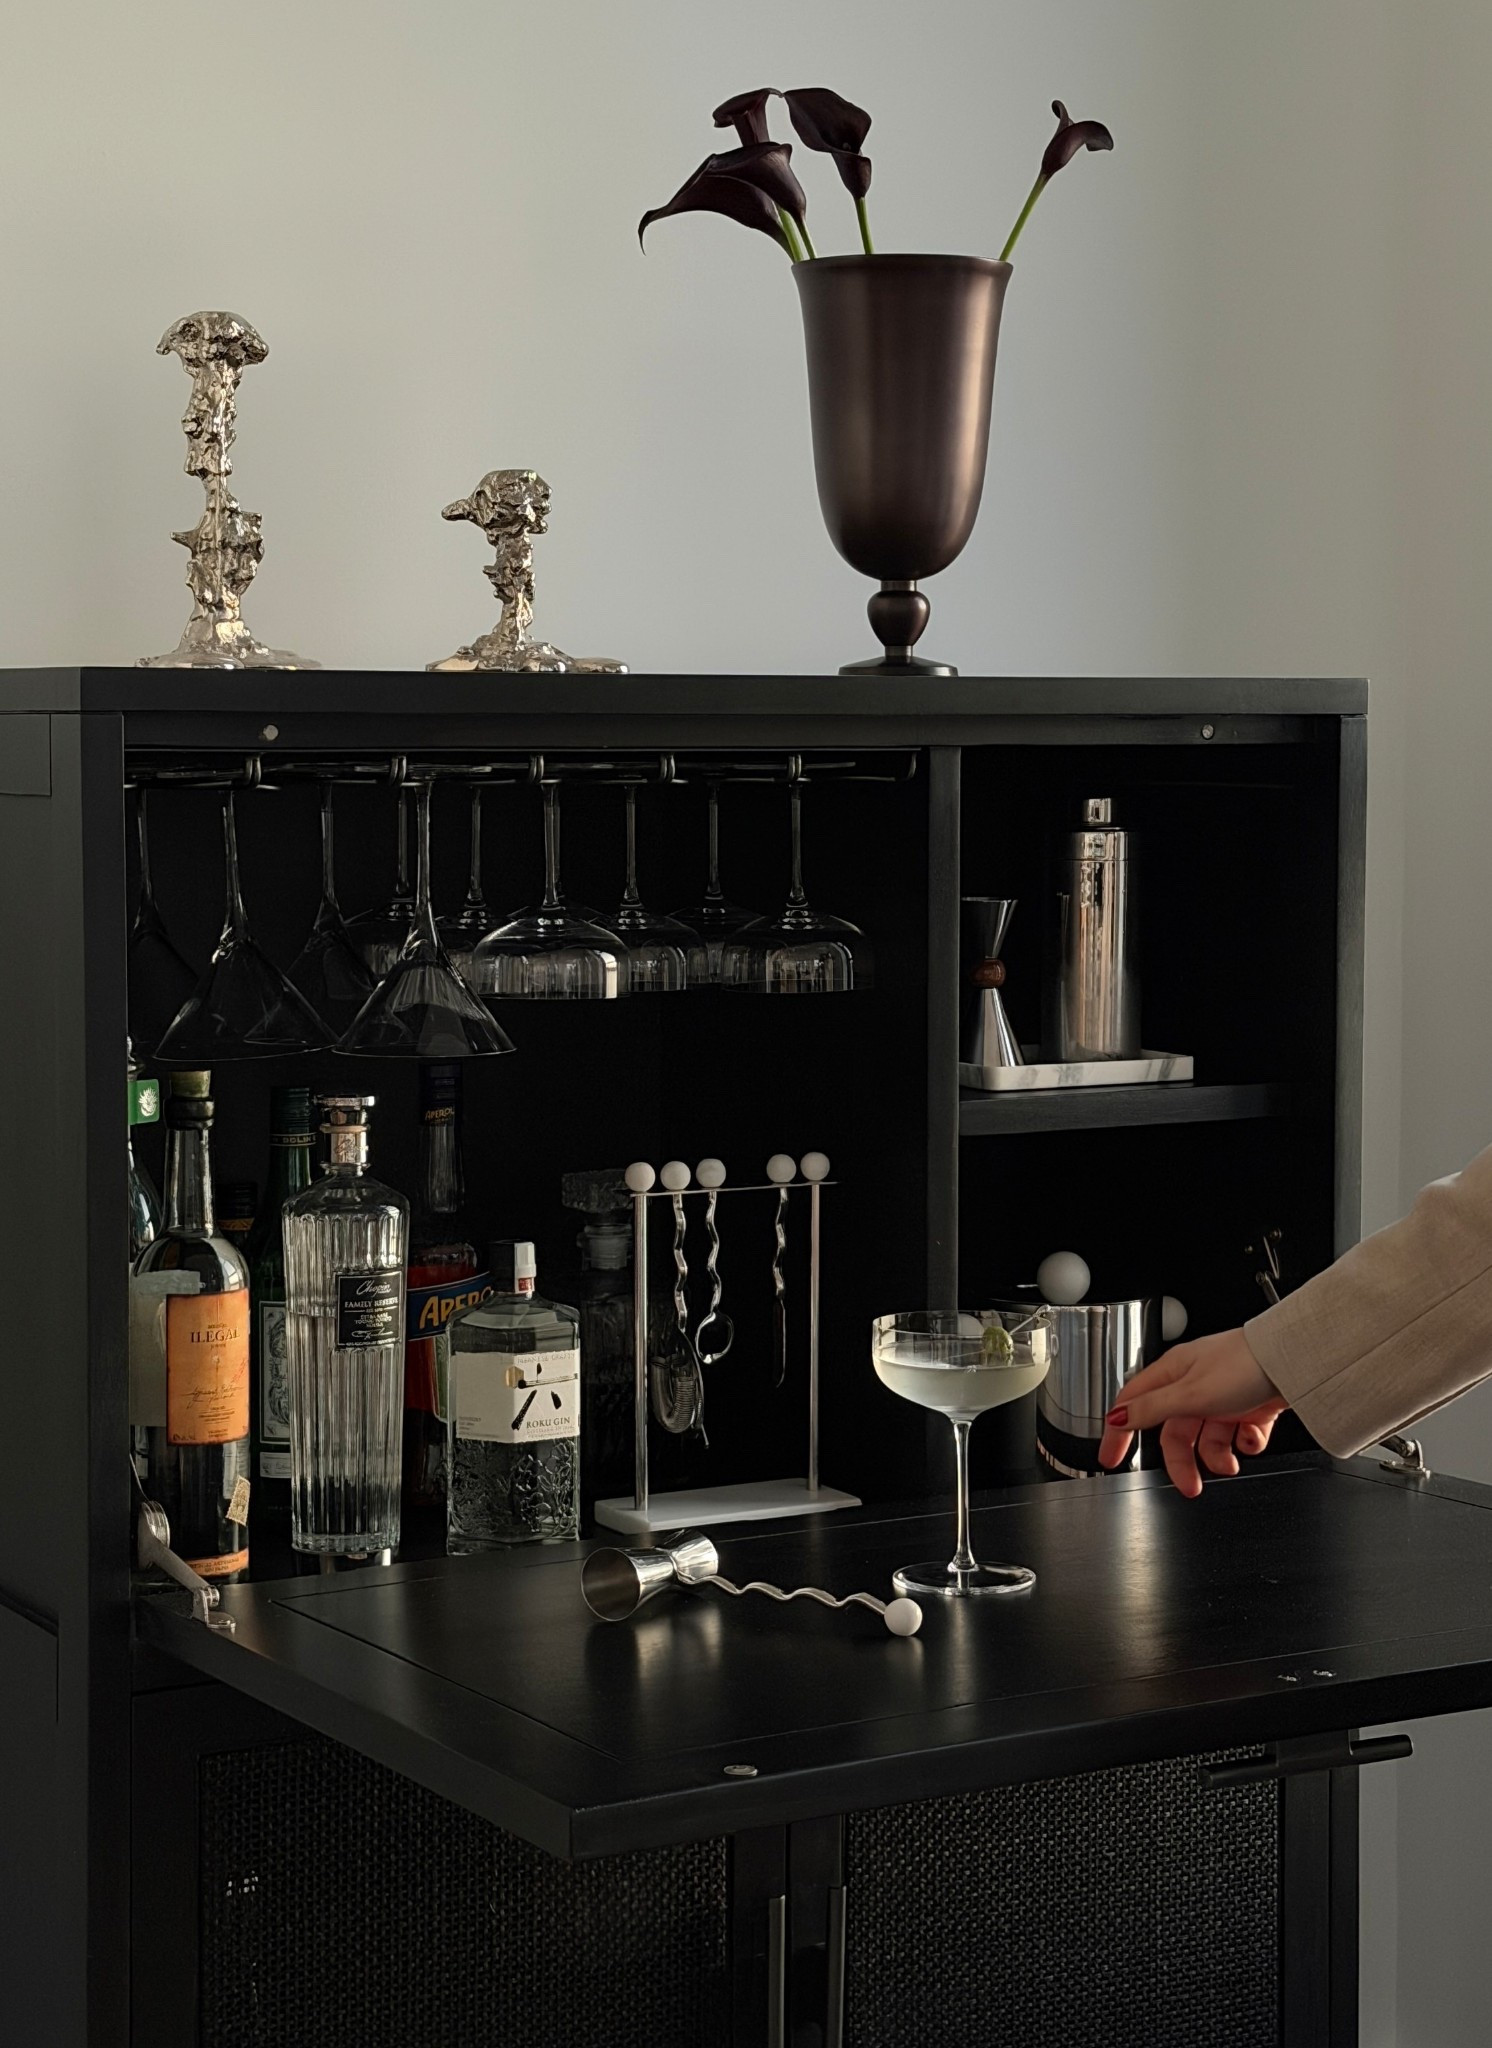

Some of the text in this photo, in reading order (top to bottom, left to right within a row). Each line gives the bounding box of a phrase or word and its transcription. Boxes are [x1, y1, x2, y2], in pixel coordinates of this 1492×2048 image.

[424, 1106, 455, 1120] APEROL
[344, 1300, 372, 1308] FAMILY
[190, 1328, 240, 1343] ILEGAL
[526, 1416, 571, 1429] ROKU GIN
